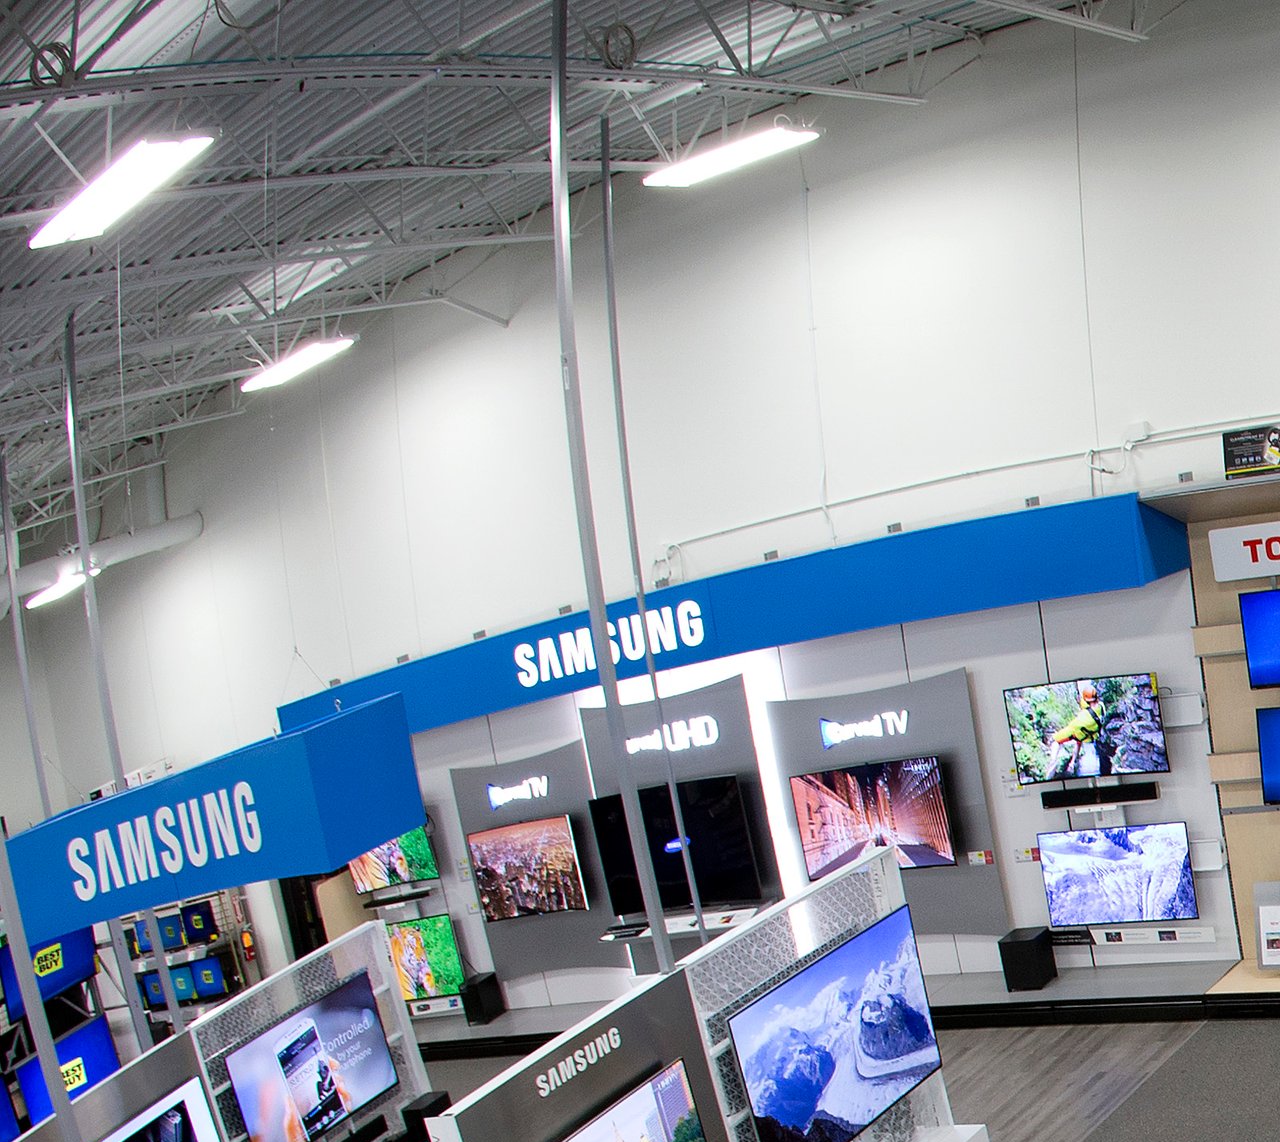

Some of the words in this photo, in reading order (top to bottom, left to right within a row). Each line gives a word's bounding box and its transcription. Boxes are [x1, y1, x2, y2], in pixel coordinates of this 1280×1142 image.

[514, 600, 705, 688] SAMSUNG
[663, 715, 720, 753] UHD
[881, 710, 909, 735] TV
[528, 776, 548, 798] TV
[67, 781, 262, 902] SAMSUNG
[37, 949, 61, 966] BEST
[39, 957, 62, 974] BUY
[536, 1026, 622, 1099] SAMSUNG
